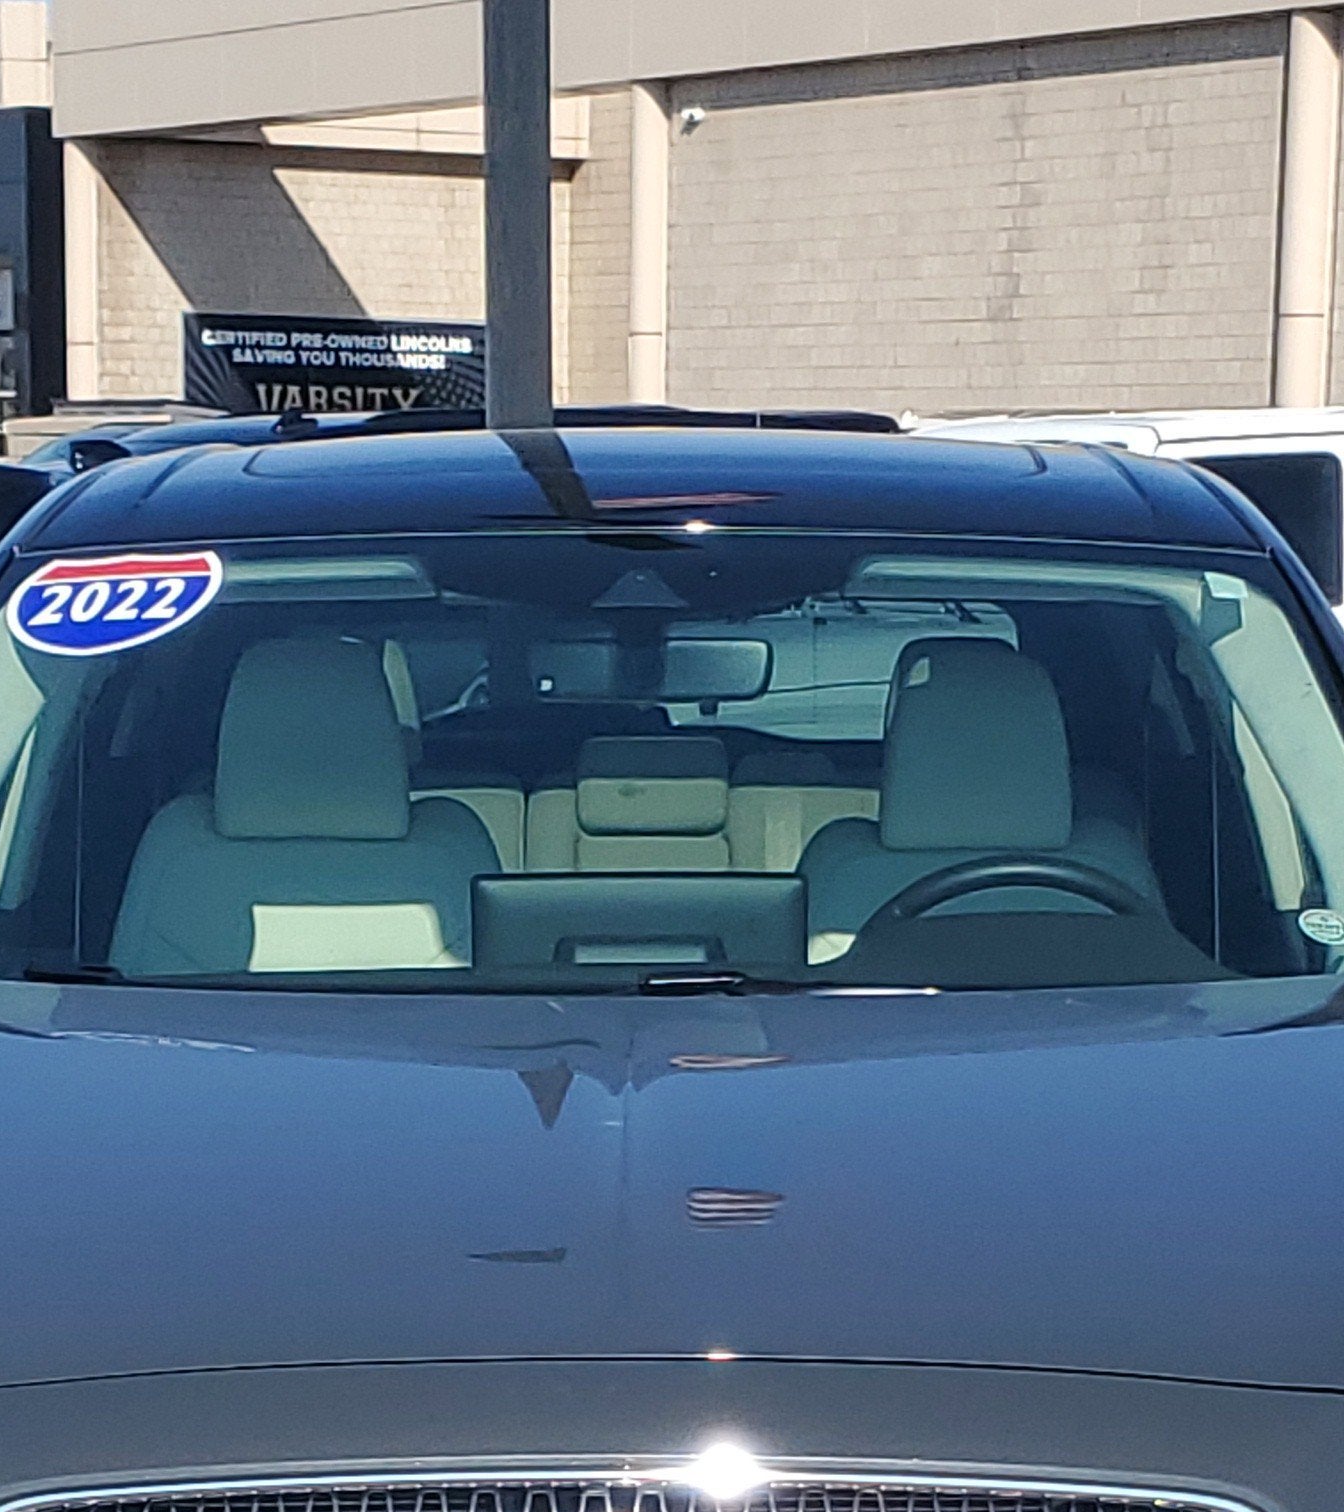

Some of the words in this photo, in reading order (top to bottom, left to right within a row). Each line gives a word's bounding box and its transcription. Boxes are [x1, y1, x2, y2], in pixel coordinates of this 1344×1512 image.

[201, 329, 288, 347] CERTIFIED
[290, 332, 389, 350] PRE-OWNED
[390, 334, 473, 354] LINCOLNS
[232, 347, 296, 364] SAVING
[299, 351, 336, 366] YOU
[338, 351, 447, 370] THOUSANDS!
[256, 382, 424, 411] VARSITY
[27, 578, 186, 626] 2022
